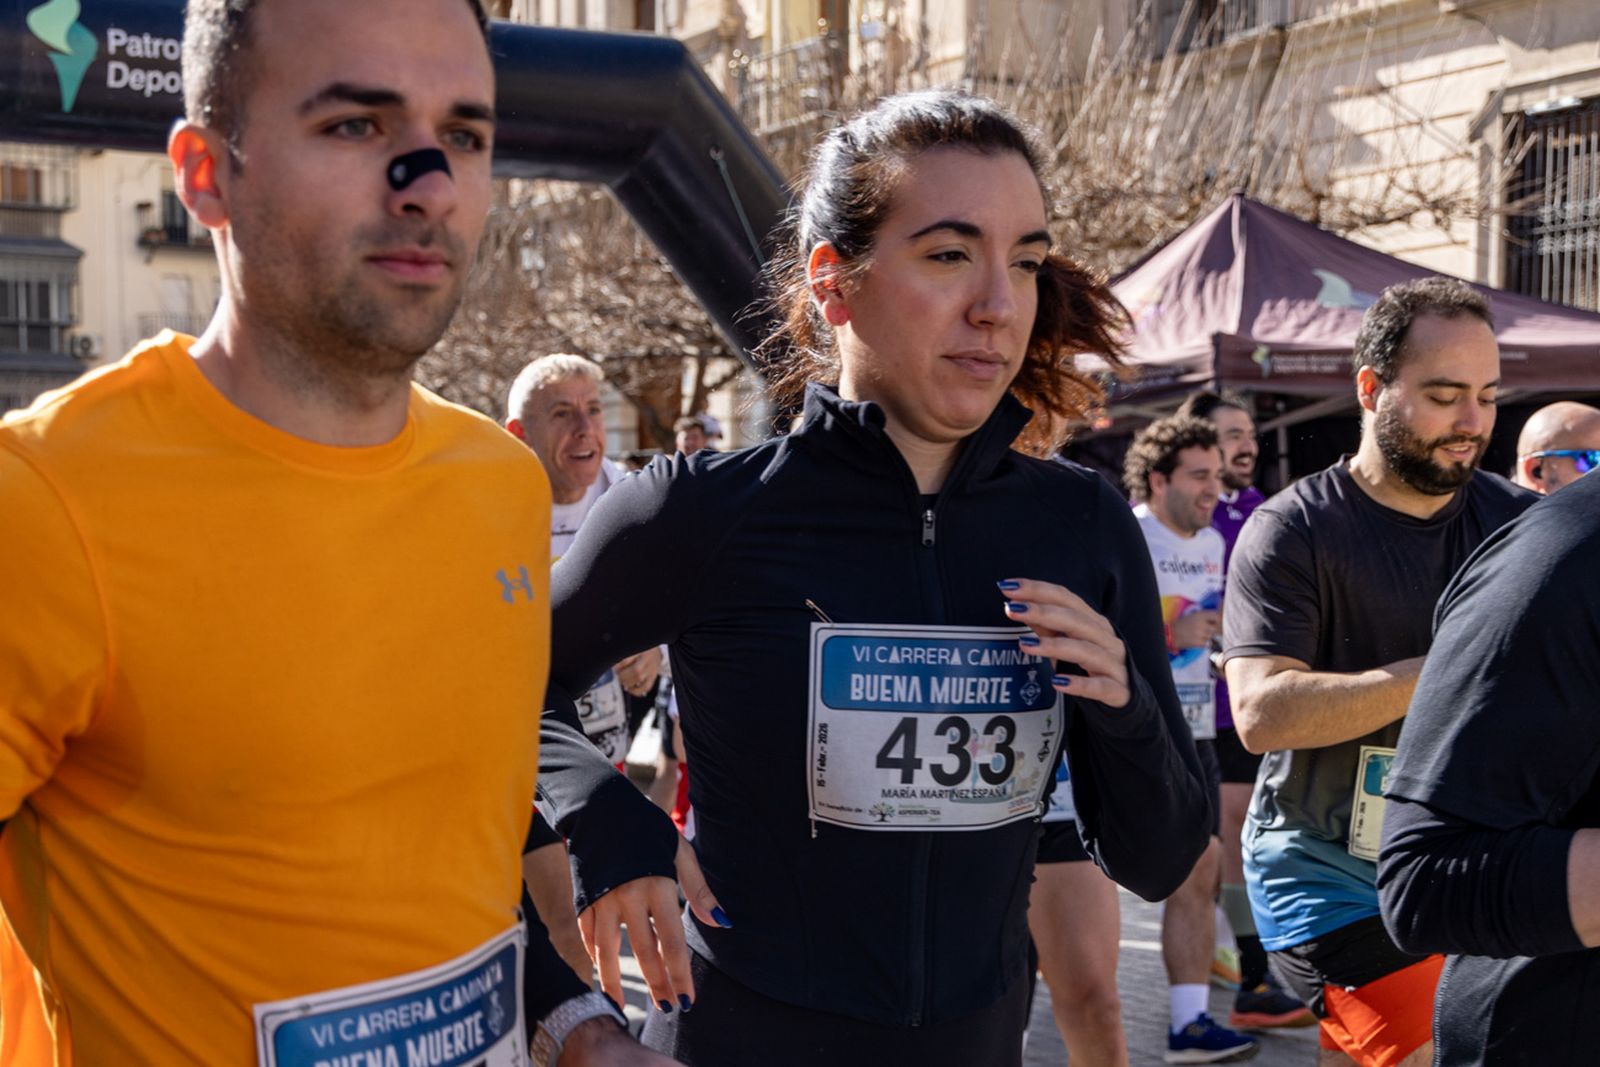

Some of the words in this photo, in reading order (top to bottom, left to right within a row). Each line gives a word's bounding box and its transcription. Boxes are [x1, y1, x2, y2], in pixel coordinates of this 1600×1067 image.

[107, 27, 180, 61] Patro
[106, 60, 182, 98] Depo
[852, 645, 870, 663] VI
[875, 646, 962, 666] CARRERA
[850, 673, 923, 704] BUENA
[930, 676, 1013, 705] MUERTE
[875, 715, 1017, 787] 433
[881, 786, 917, 799] MARÍA
[309, 1022, 336, 1049] VI
[338, 997, 437, 1042] CARRERA
[405, 1010, 485, 1067] MUERTE
